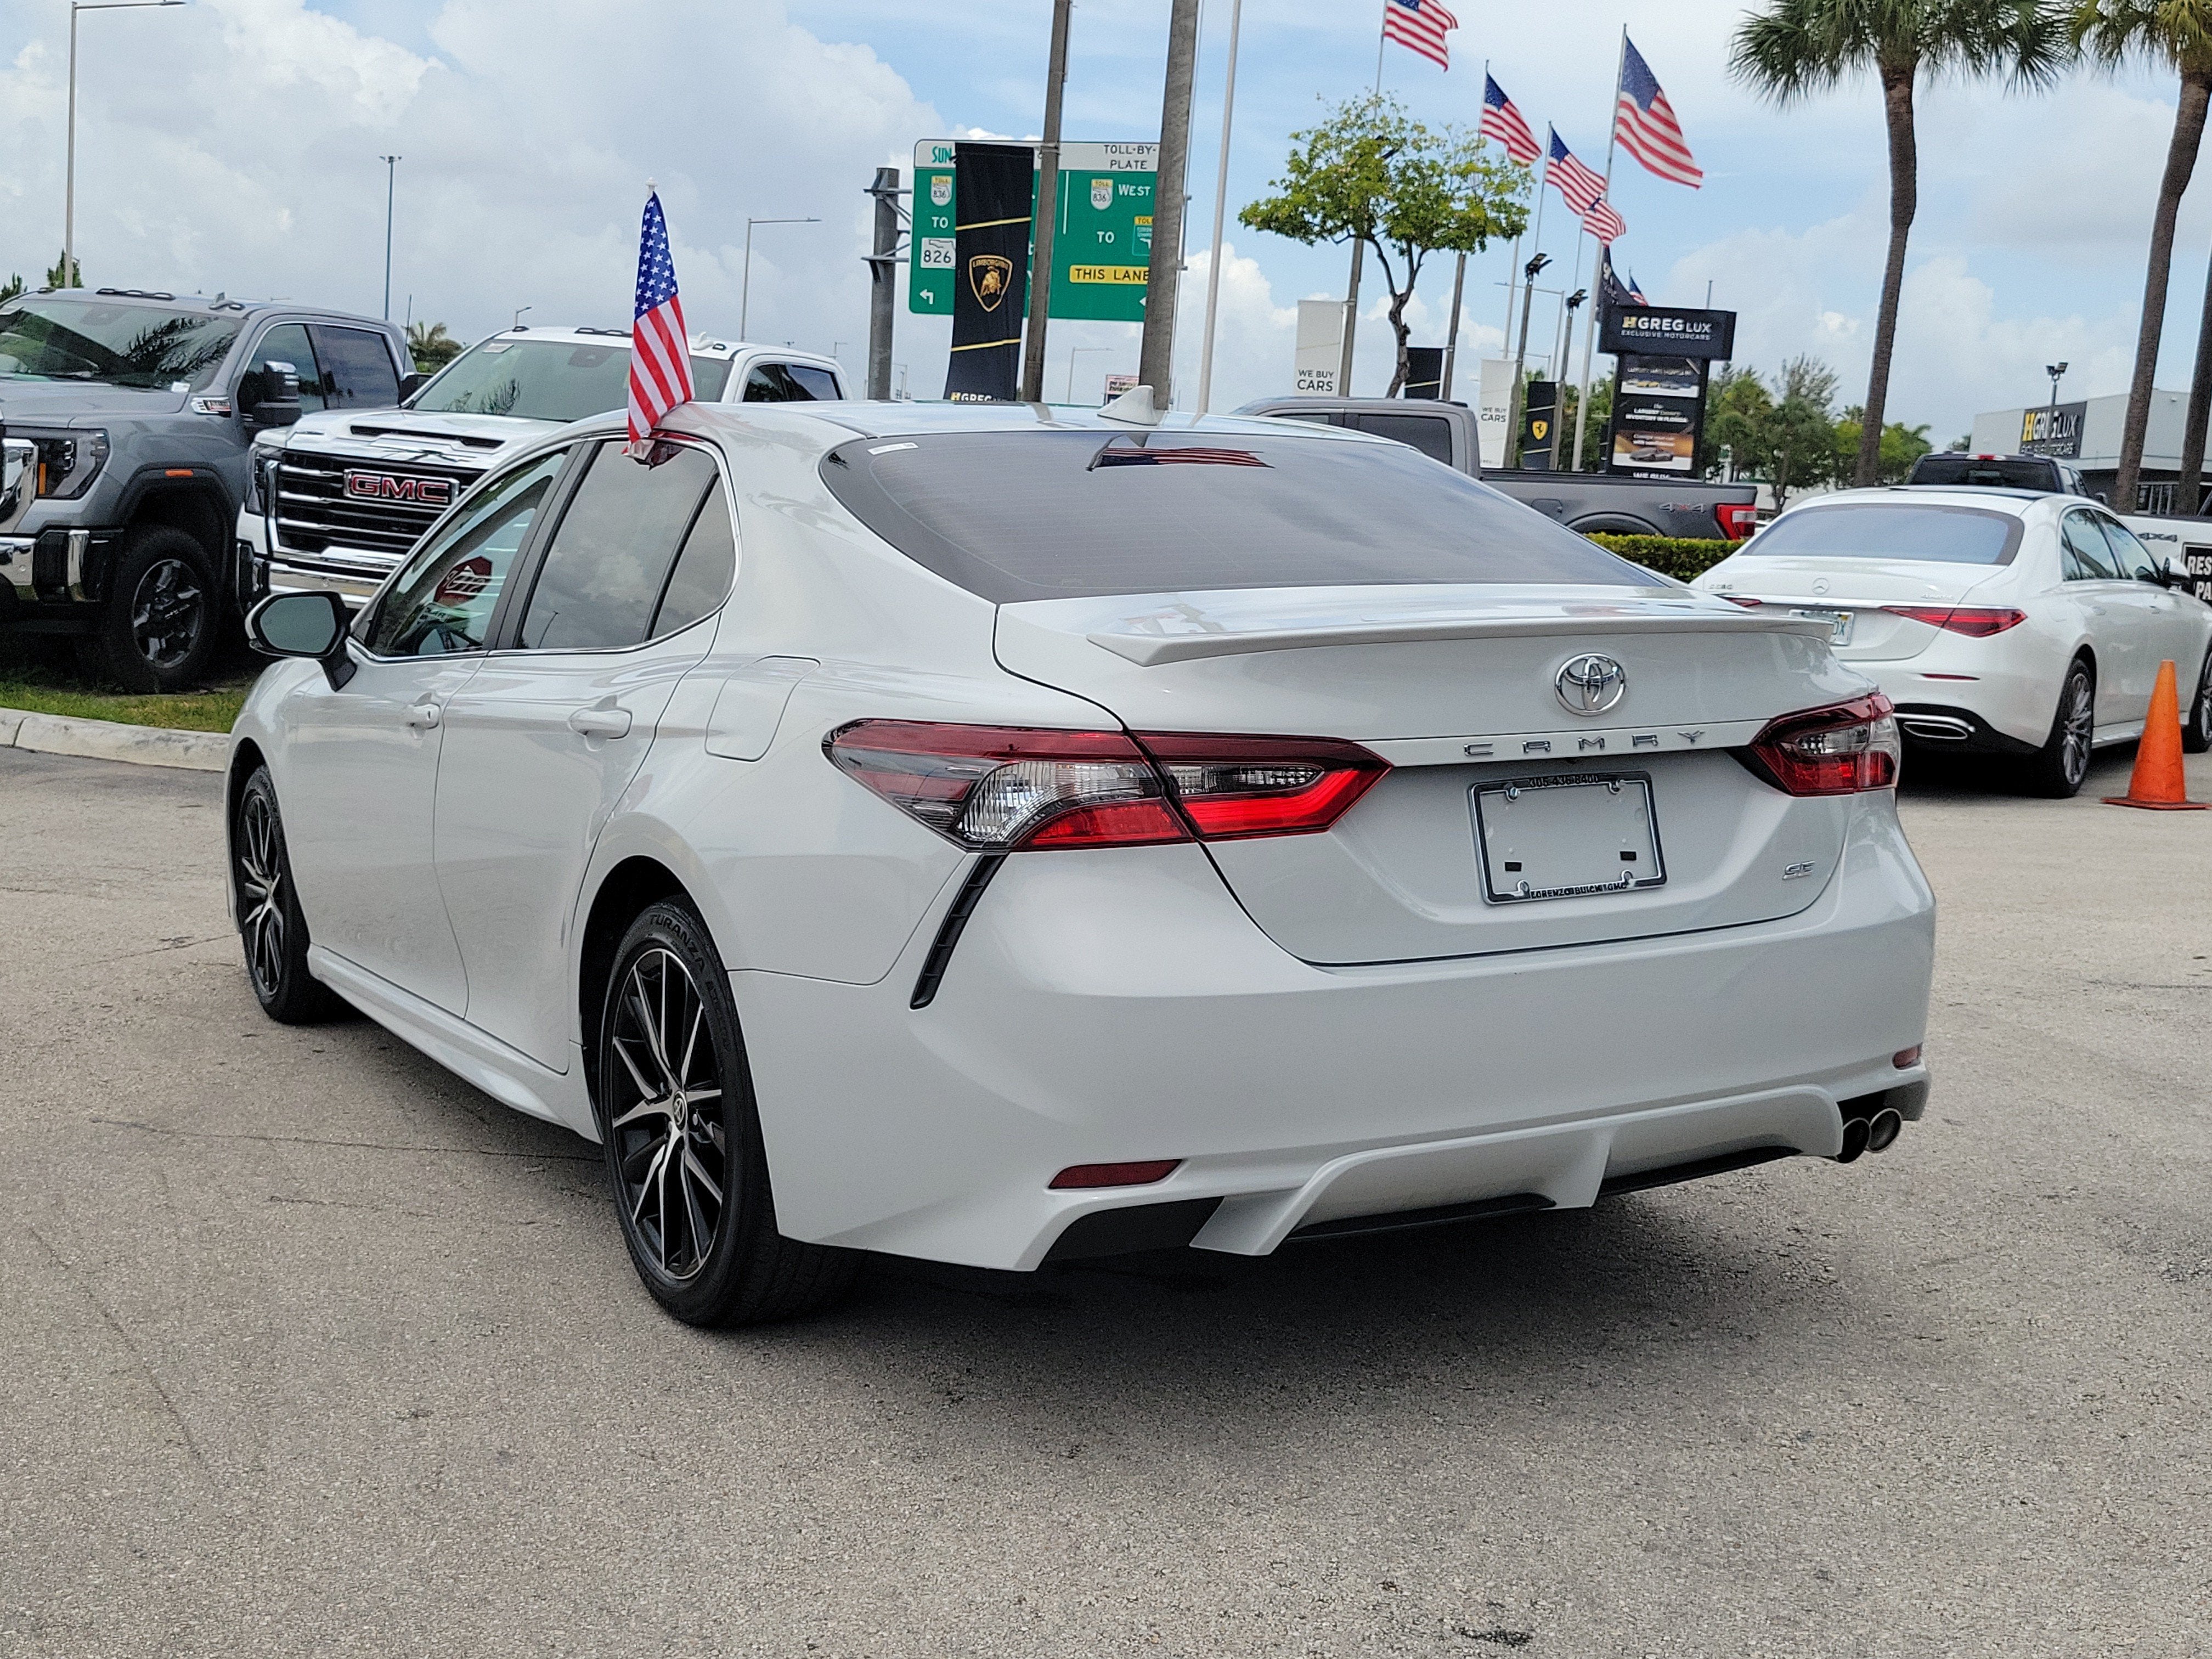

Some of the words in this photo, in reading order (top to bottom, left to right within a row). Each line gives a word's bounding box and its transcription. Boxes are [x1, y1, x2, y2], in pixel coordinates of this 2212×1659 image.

[932, 146, 951, 163] SUN
[1110, 159, 1147, 170] PLATE
[1119, 184, 1150, 196] WEST
[932, 216, 949, 228] TO
[1097, 231, 1115, 244] TO
[923, 250, 951, 263] 826
[1075, 268, 1105, 280] THIS
[1297, 379, 1333, 392] CARS
[1482, 414, 1506, 422] CARS
[2056, 414, 2078, 438] LUX
[351, 474, 449, 503] GMC
[2187, 555, 2212, 575] RES
[1464, 730, 1705, 757] CAMRY
[1782, 860, 1815, 880] SE
[1530, 887, 1572, 899] LORENZO
[1574, 884, 1600, 895] BUICK
[650, 915, 704, 973] TURANZA
